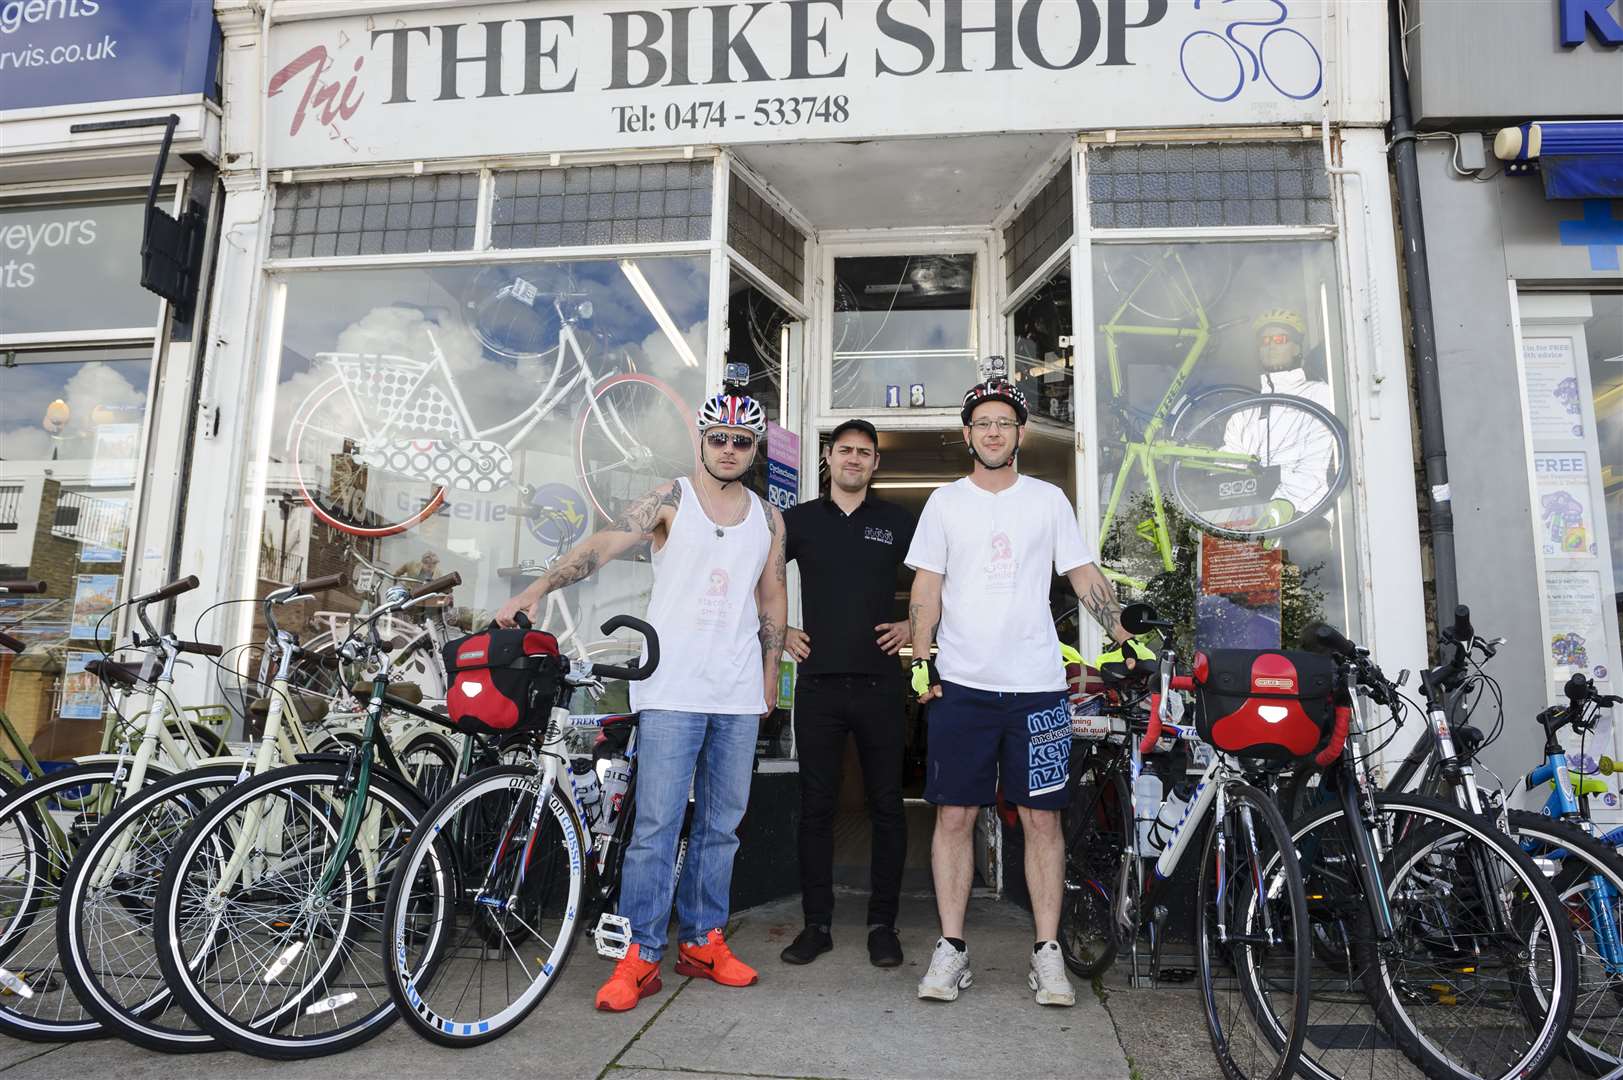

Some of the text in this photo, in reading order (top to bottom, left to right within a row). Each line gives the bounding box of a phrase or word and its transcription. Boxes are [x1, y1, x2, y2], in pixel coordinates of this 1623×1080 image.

[0, 0, 101, 33] gents
[0, 36, 117, 70] rvis.co.uk
[369, 0, 1168, 105] THE BIKE SHOP
[267, 45, 366, 137] Tri
[611, 104, 656, 133] Tel:
[664, 101, 727, 132] 0474
[753, 94, 850, 126] 533748
[1534, 458, 1584, 472] FREE
[571, 717, 596, 726] TREK
